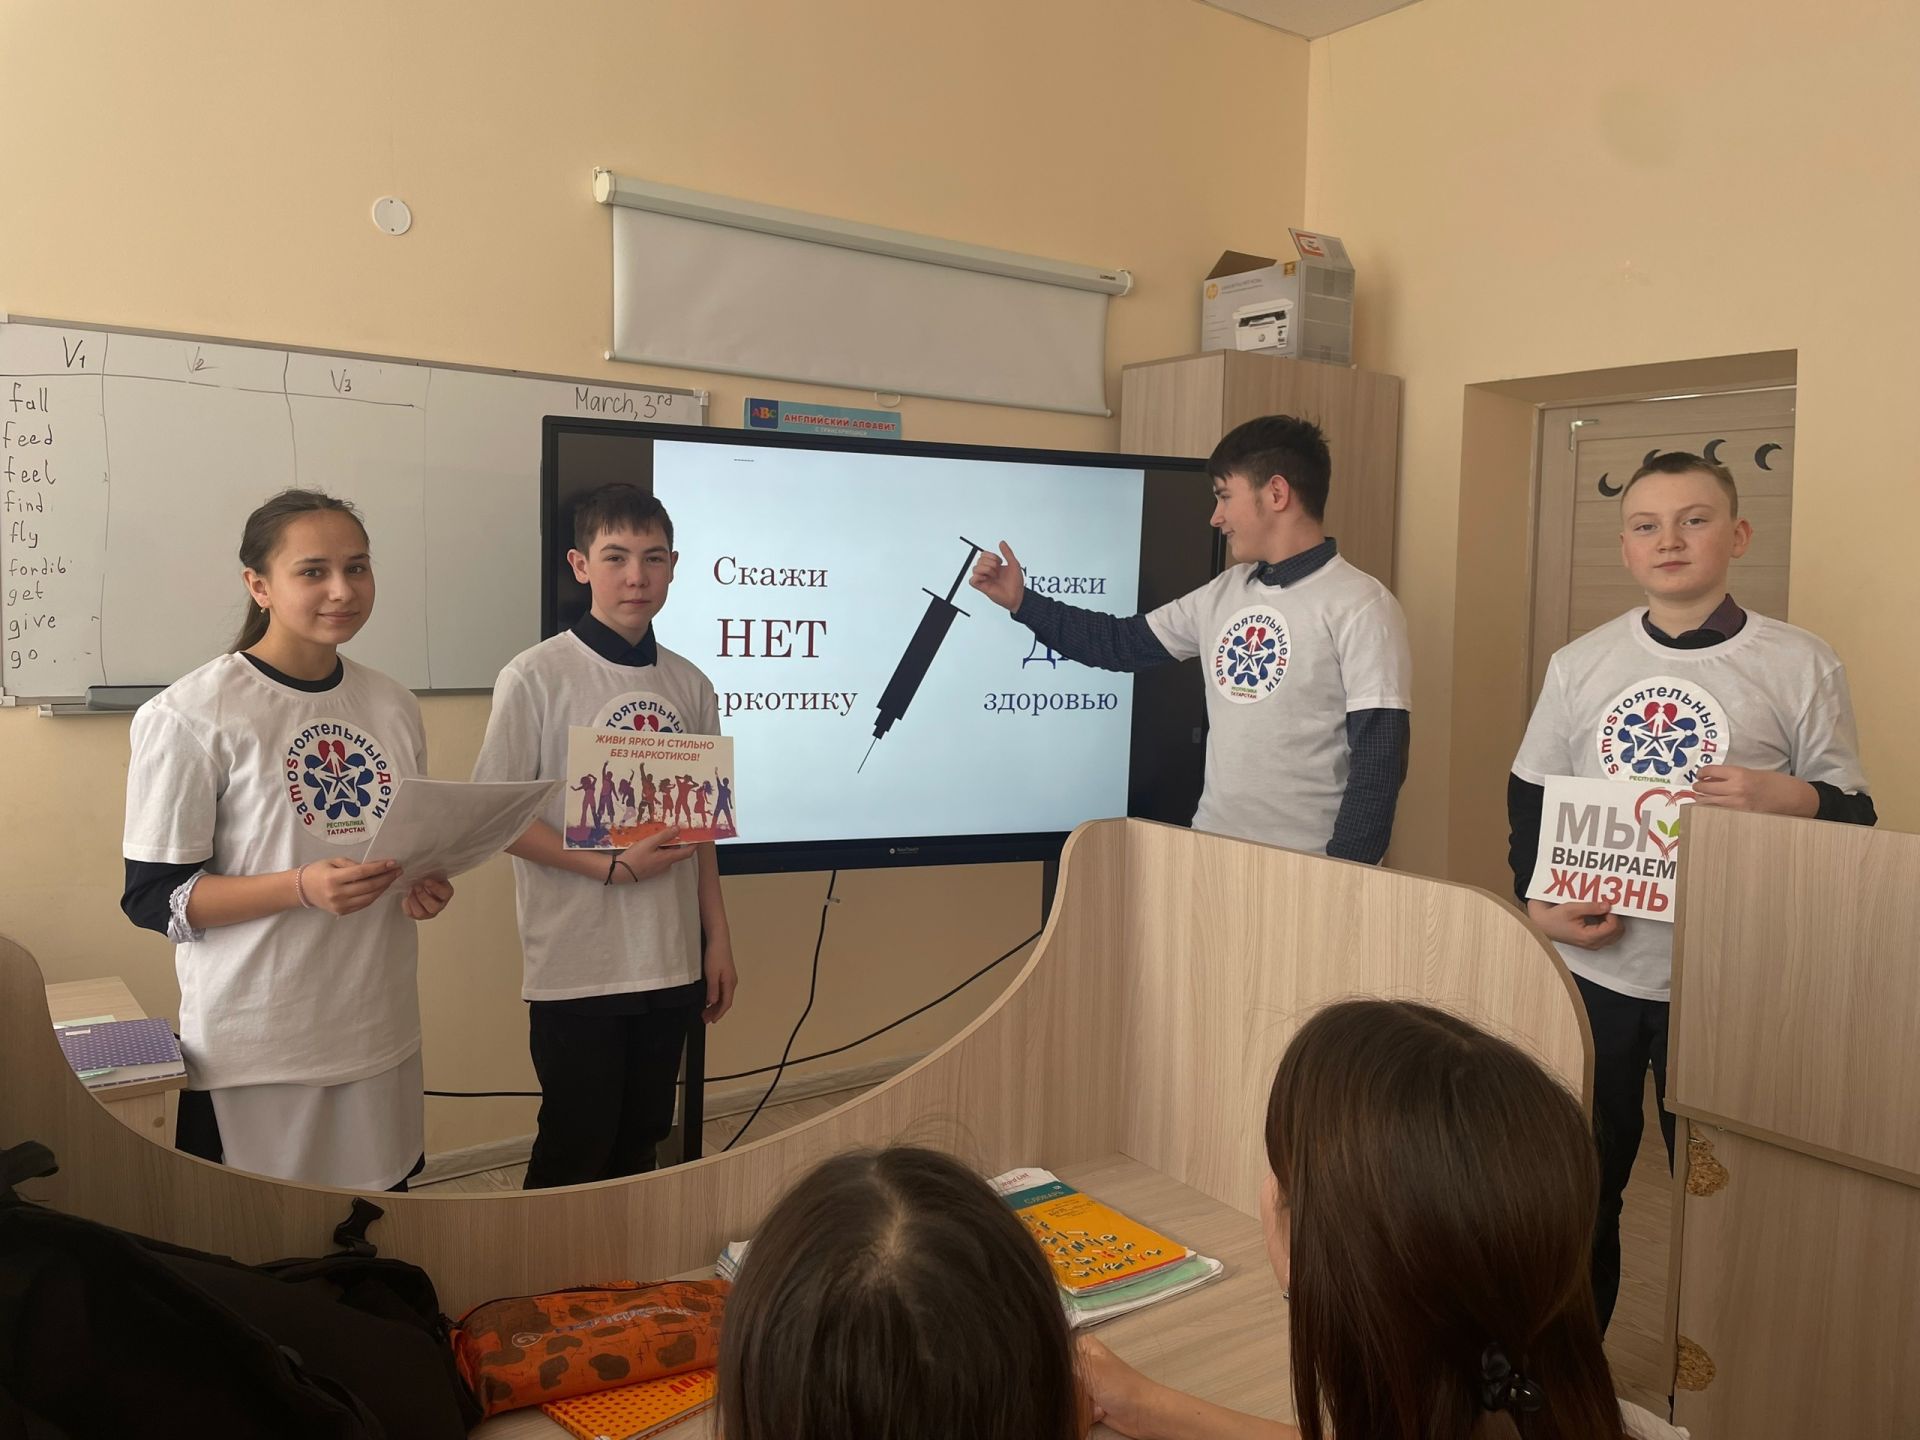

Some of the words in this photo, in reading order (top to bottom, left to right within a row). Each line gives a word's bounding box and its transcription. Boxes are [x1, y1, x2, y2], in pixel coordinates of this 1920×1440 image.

[9, 382, 49, 413] fall
[574, 386, 639, 421] March,
[642, 394, 673, 419] 3rd
[751, 406, 777, 419] ABC
[783, 412, 850, 428] АНГЛИЙСКИЙ
[851, 419, 897, 432] АЛФАВИТ
[2, 420, 54, 449] feed
[3, 455, 57, 485] feel
[4, 489, 44, 513] find
[9, 520, 39, 549] fly
[713, 556, 829, 588] Скажи
[1018, 566, 1107, 595] кажи
[7, 580, 44, 607] get
[7, 613, 57, 641] give
[716, 618, 827, 659] НЕТ
[983, 691, 1119, 717] здоровью
[595, 735, 626, 745] ЖИВИ
[628, 737, 655, 747] ЯРКО
[657, 739, 665, 747] И
[667, 740, 715, 750] СТИЛЬНО
[610, 749, 628, 758] БЕЗ
[630, 751, 700, 762] НАРКОТИКОВ!
[326, 821, 365, 829] РЕСПУБЛИКА
[326, 827, 366, 836] ТАТАРСТАН
[1555, 802, 1652, 853] МЫ
[1551, 847, 1677, 880] ВЫБИРАЕМ
[1543, 868, 1669, 913] ЖИЗНЬ
